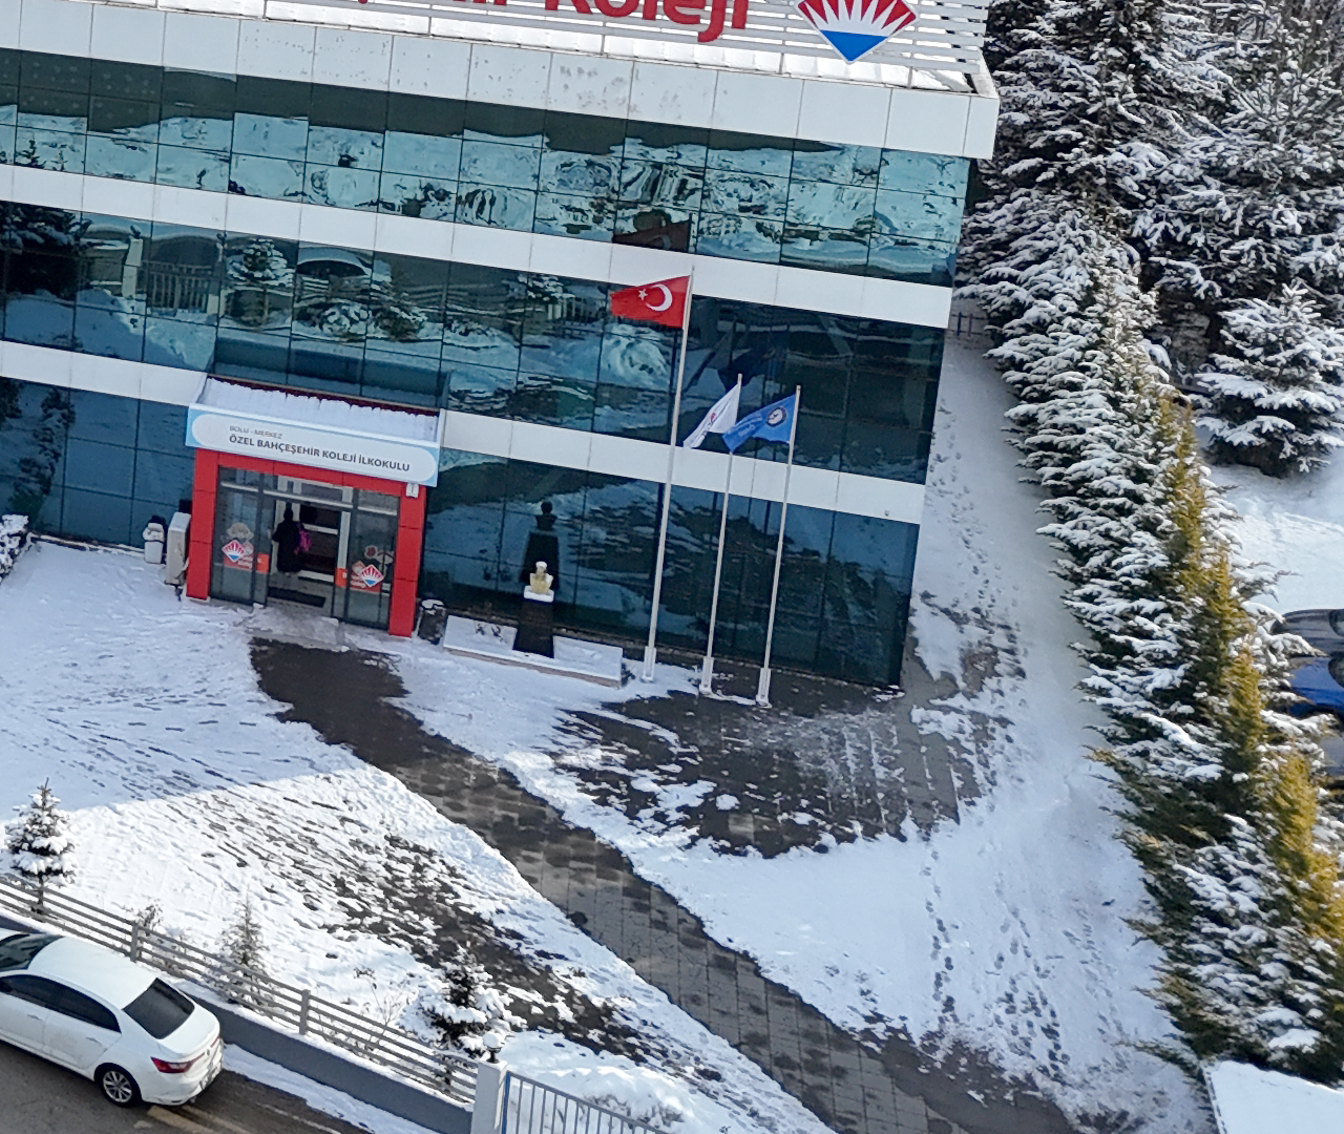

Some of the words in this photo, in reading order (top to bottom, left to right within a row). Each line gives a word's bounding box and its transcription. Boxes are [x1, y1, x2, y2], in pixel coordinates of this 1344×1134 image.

[229, 426, 250, 434] BOLU
[254, 429, 283, 439] MERKEZ
[229, 433, 254, 446] ÖZEL
[257, 439, 320, 457] BAHÇEŞEHİR
[322, 450, 357, 463] KOLEJİ
[358, 453, 410, 472] İLKOKULU
